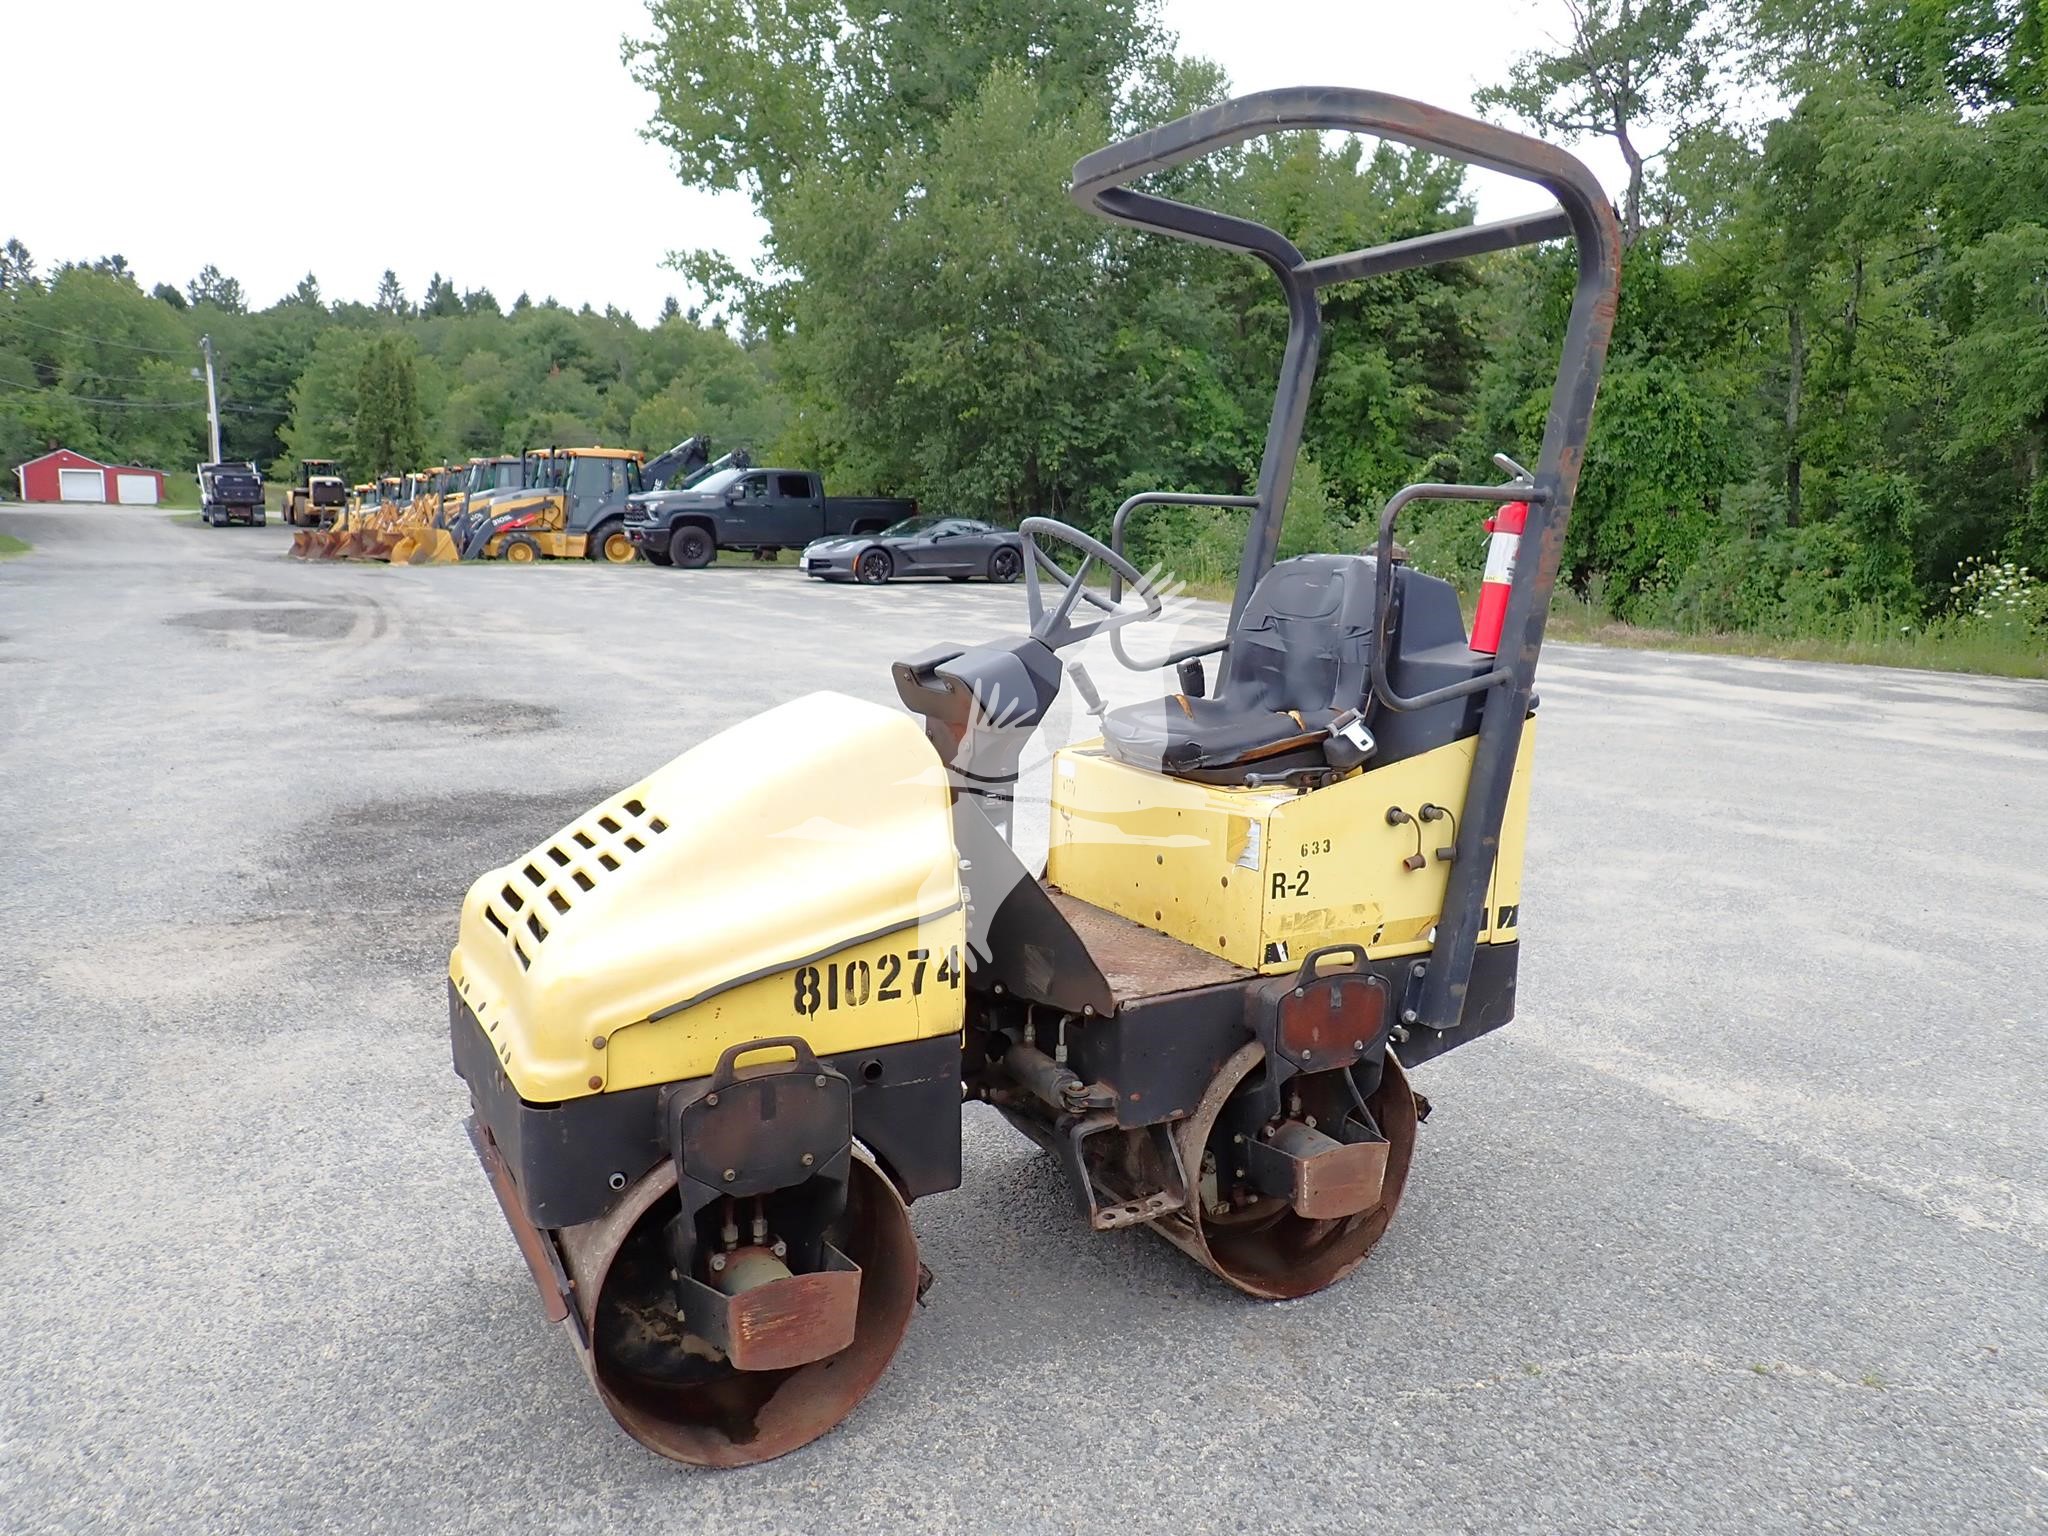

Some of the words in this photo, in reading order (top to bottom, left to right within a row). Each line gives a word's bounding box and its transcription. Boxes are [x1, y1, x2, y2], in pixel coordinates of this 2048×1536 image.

[1301, 839, 1330, 857] 633
[1271, 870, 1310, 900] R-2
[794, 945, 961, 1015] 810274
